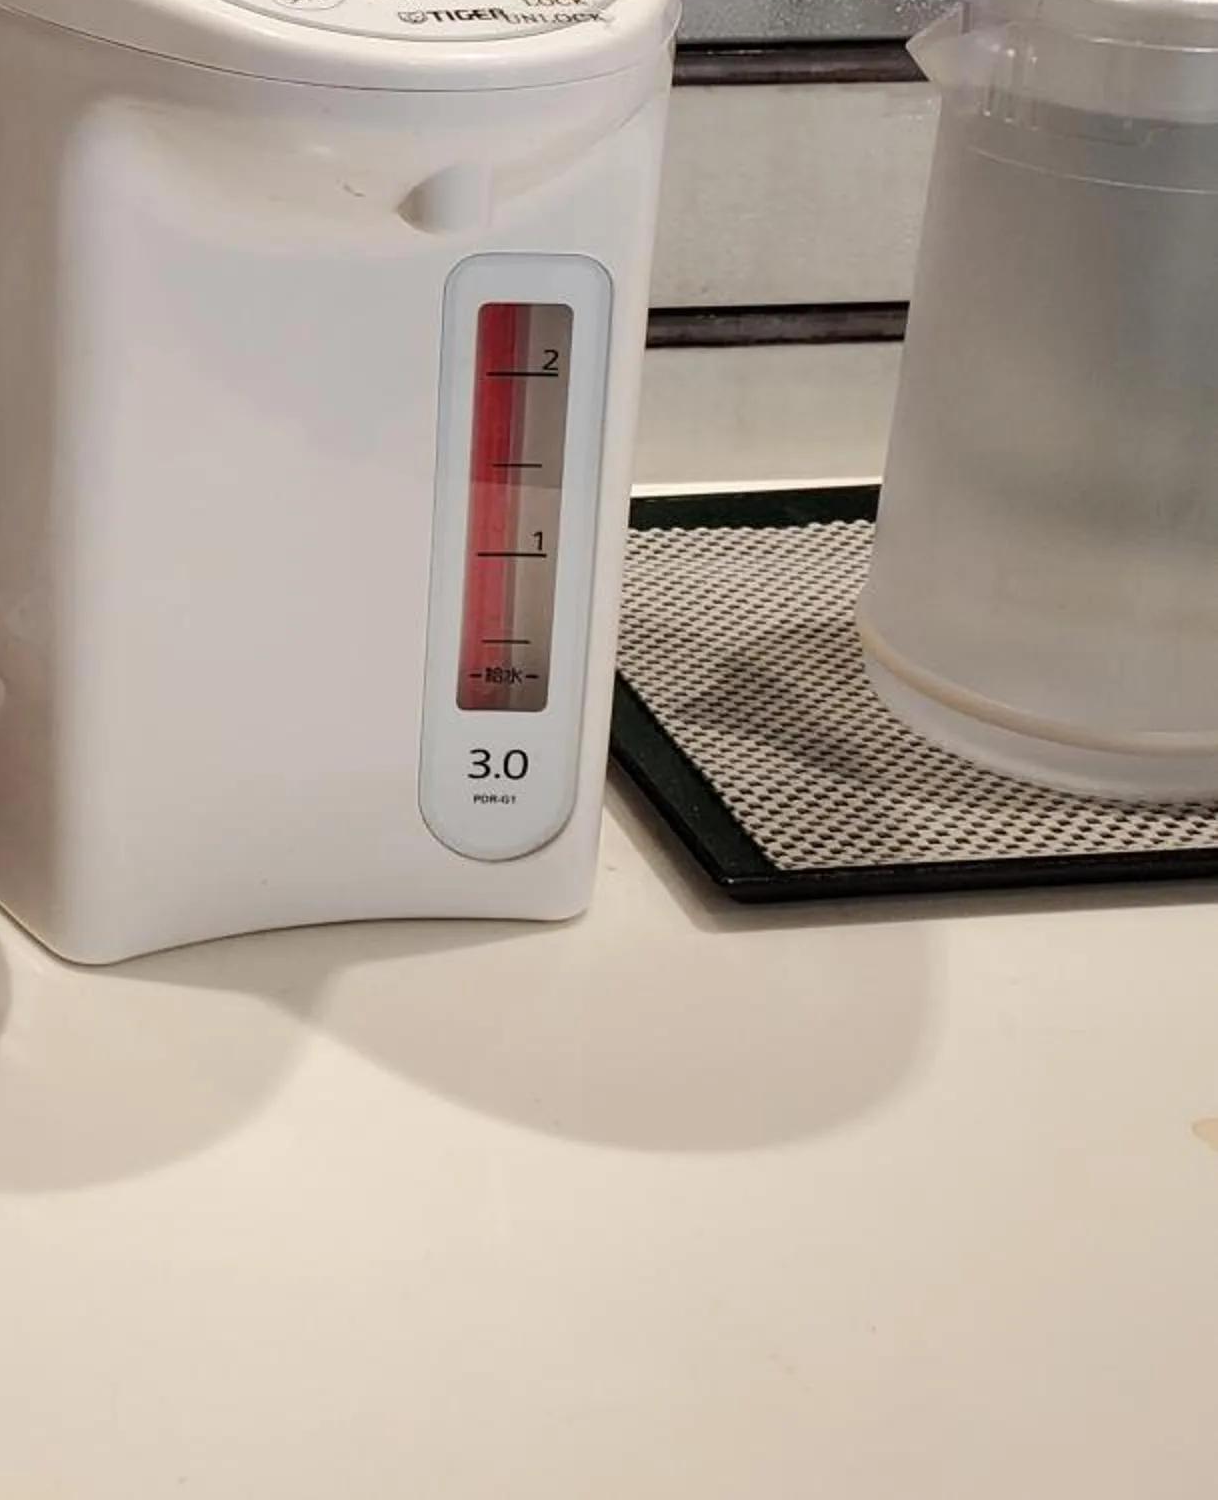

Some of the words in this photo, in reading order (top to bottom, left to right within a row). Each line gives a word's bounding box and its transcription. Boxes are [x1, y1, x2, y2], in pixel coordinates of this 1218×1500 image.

[427, 8, 507, 23] TIGER
[543, 350, 560, 371] 2
[533, 532, 544, 550] 1
[467, 748, 530, 780] 3.0
